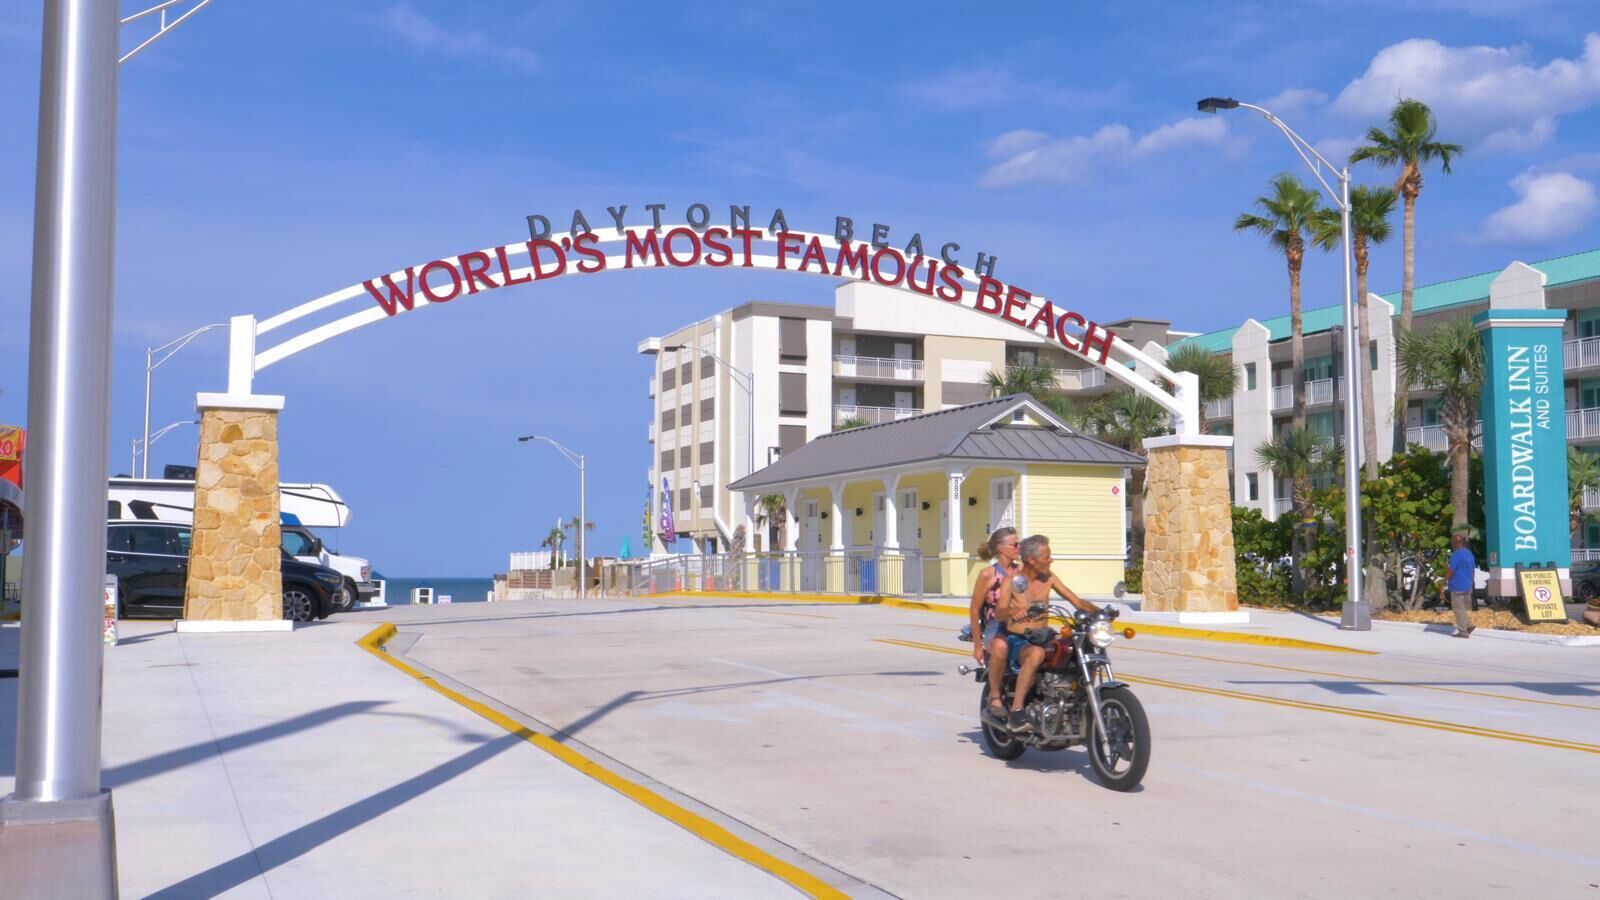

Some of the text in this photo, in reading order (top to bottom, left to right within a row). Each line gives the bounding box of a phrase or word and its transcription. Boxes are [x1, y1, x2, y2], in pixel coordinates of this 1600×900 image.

[363, 227, 1117, 366] WORLD'S MOST FAMOUS BEACH
[526, 203, 998, 278] DAYTONA BEACH
[1533, 344, 1550, 430] AND SUITES
[1507, 345, 1538, 551] BOARDWALK INN
